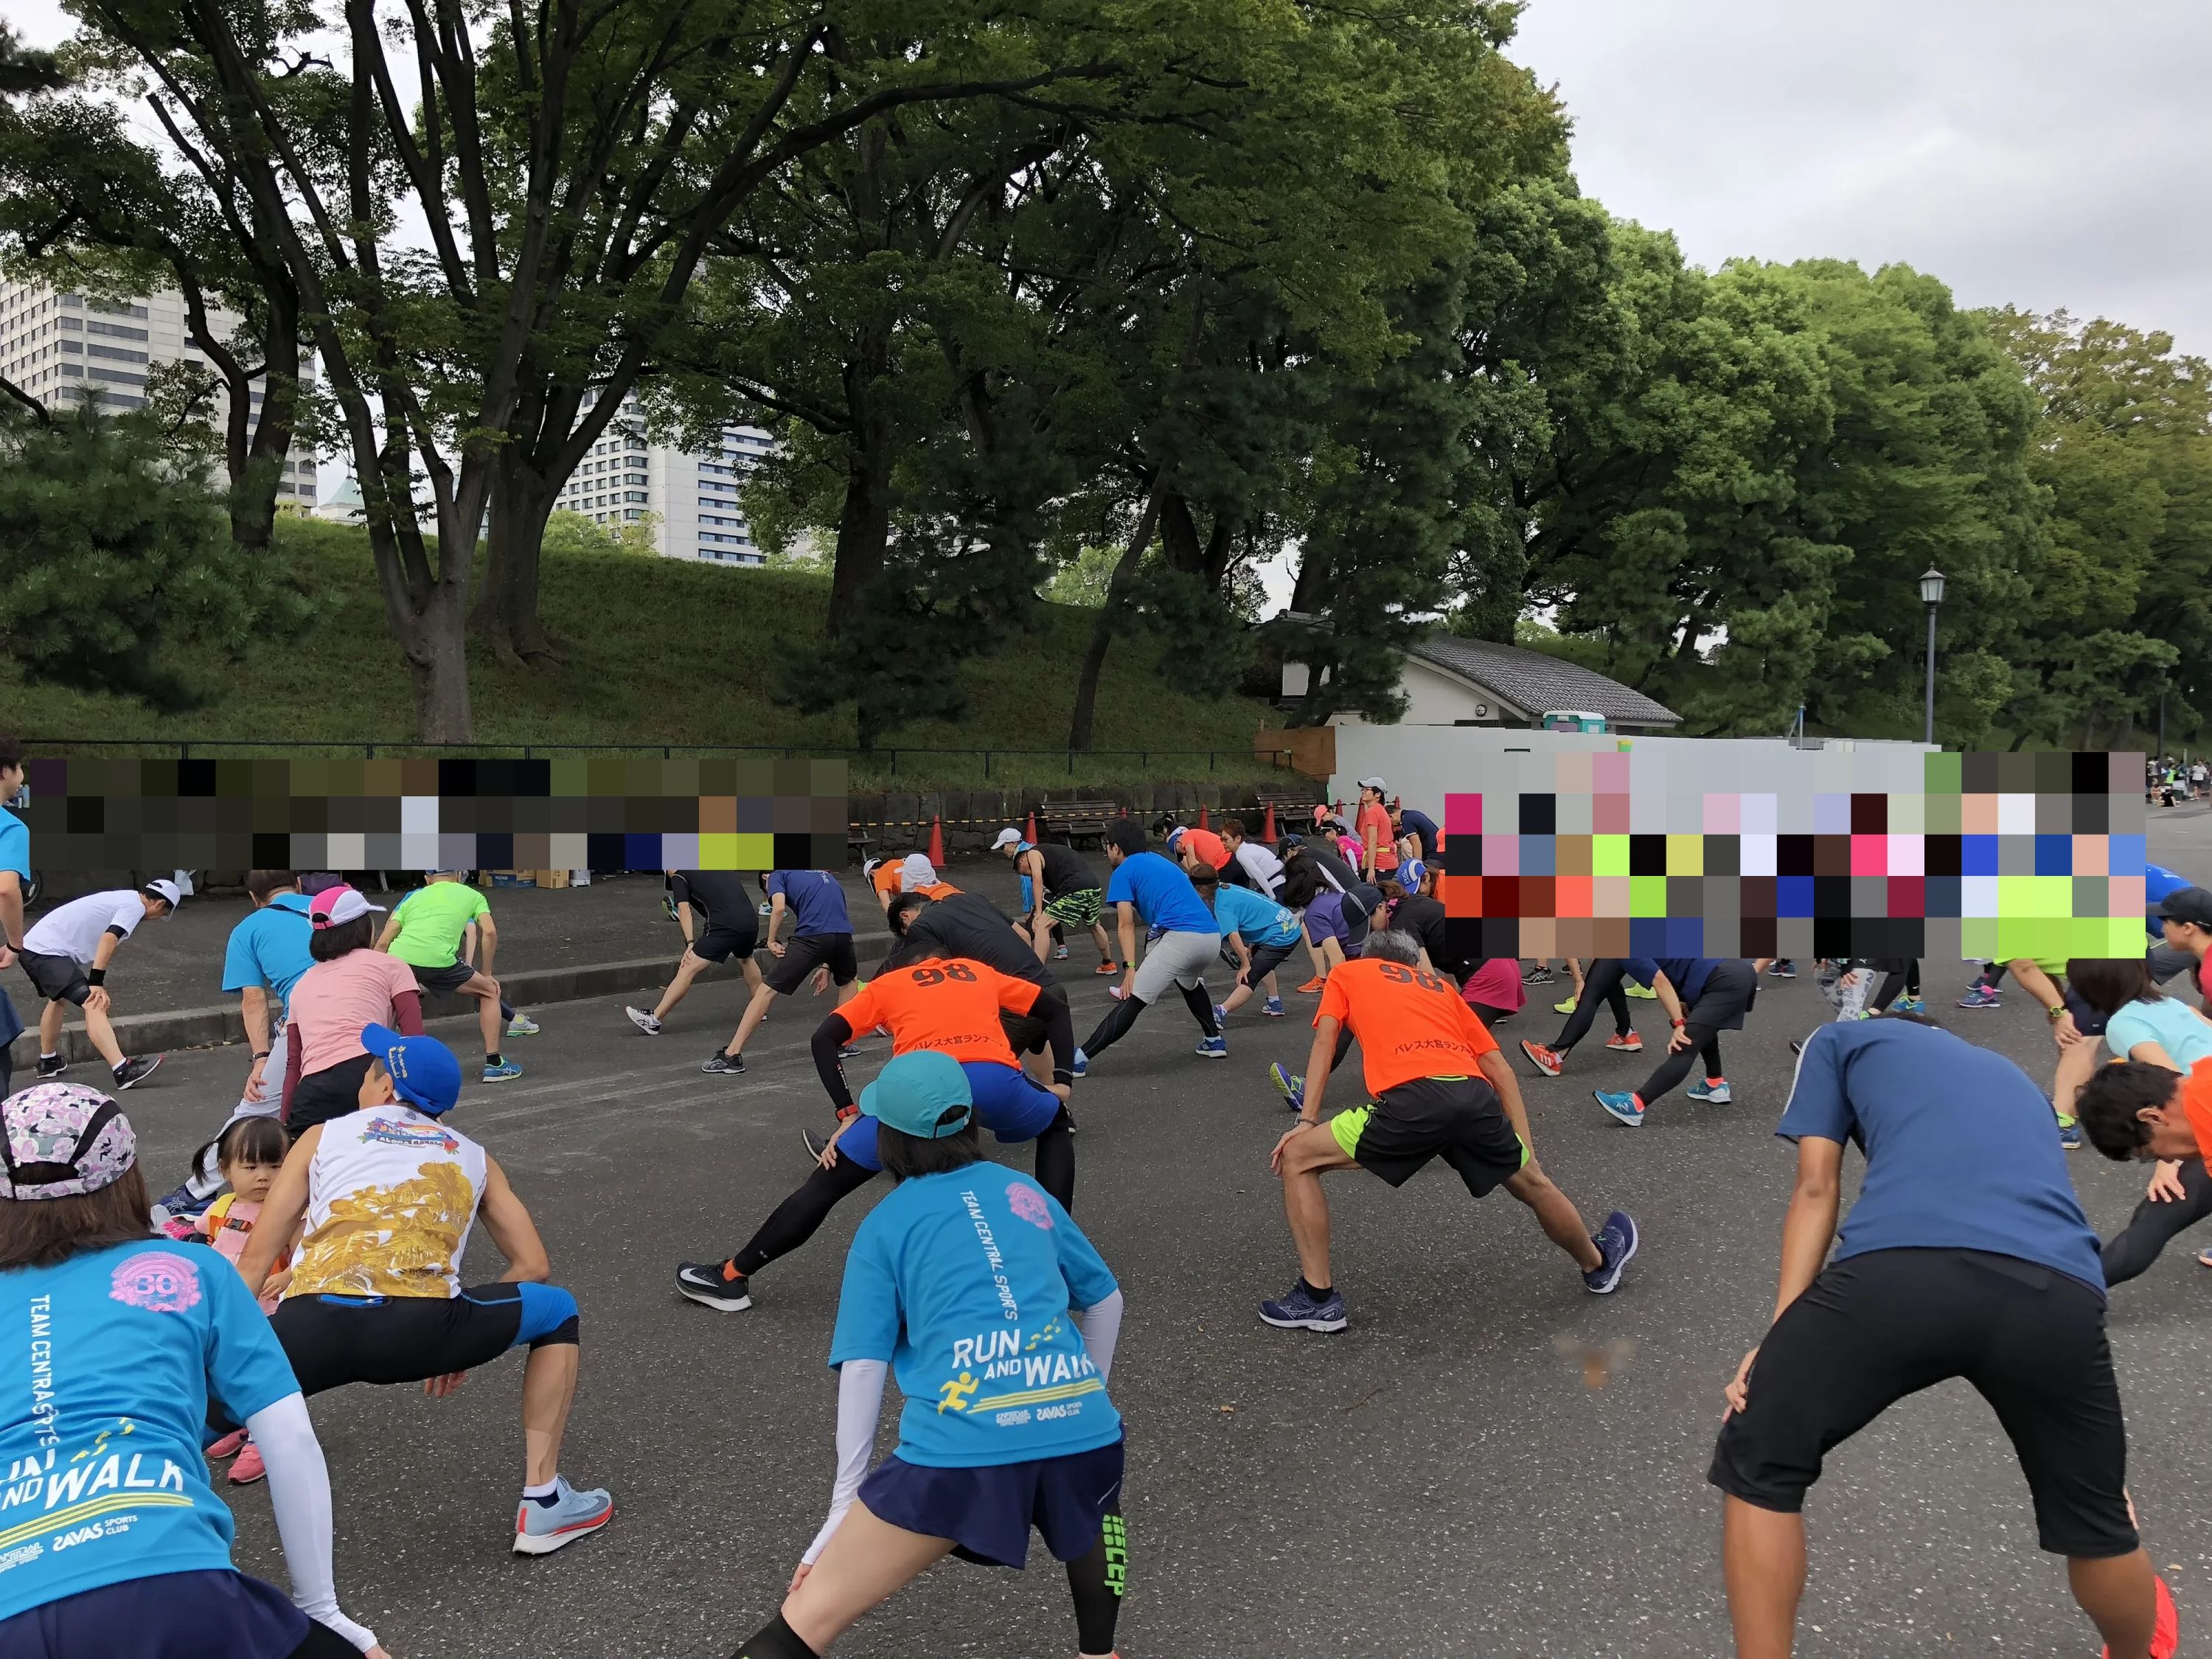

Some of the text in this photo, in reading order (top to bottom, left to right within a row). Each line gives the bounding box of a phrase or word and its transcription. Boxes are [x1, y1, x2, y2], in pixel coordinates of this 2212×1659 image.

[911, 963, 978, 987] 98
[1379, 964, 1445, 992] 98
[960, 1190, 1018, 1321] TEAM CENTRAL SPORTS
[30, 1294, 51, 1338] TEAM
[952, 1329, 1020, 1369] RUN
[30, 1340, 55, 1402] CENTRA
[984, 1352, 1096, 1388] AND WALK
[1067, 1408, 1080, 1416] CLUB
[0, 1453, 184, 1510] ND WALK
[105, 1515, 138, 1528] SPORTS
[105, 1525, 130, 1536] CLUB
